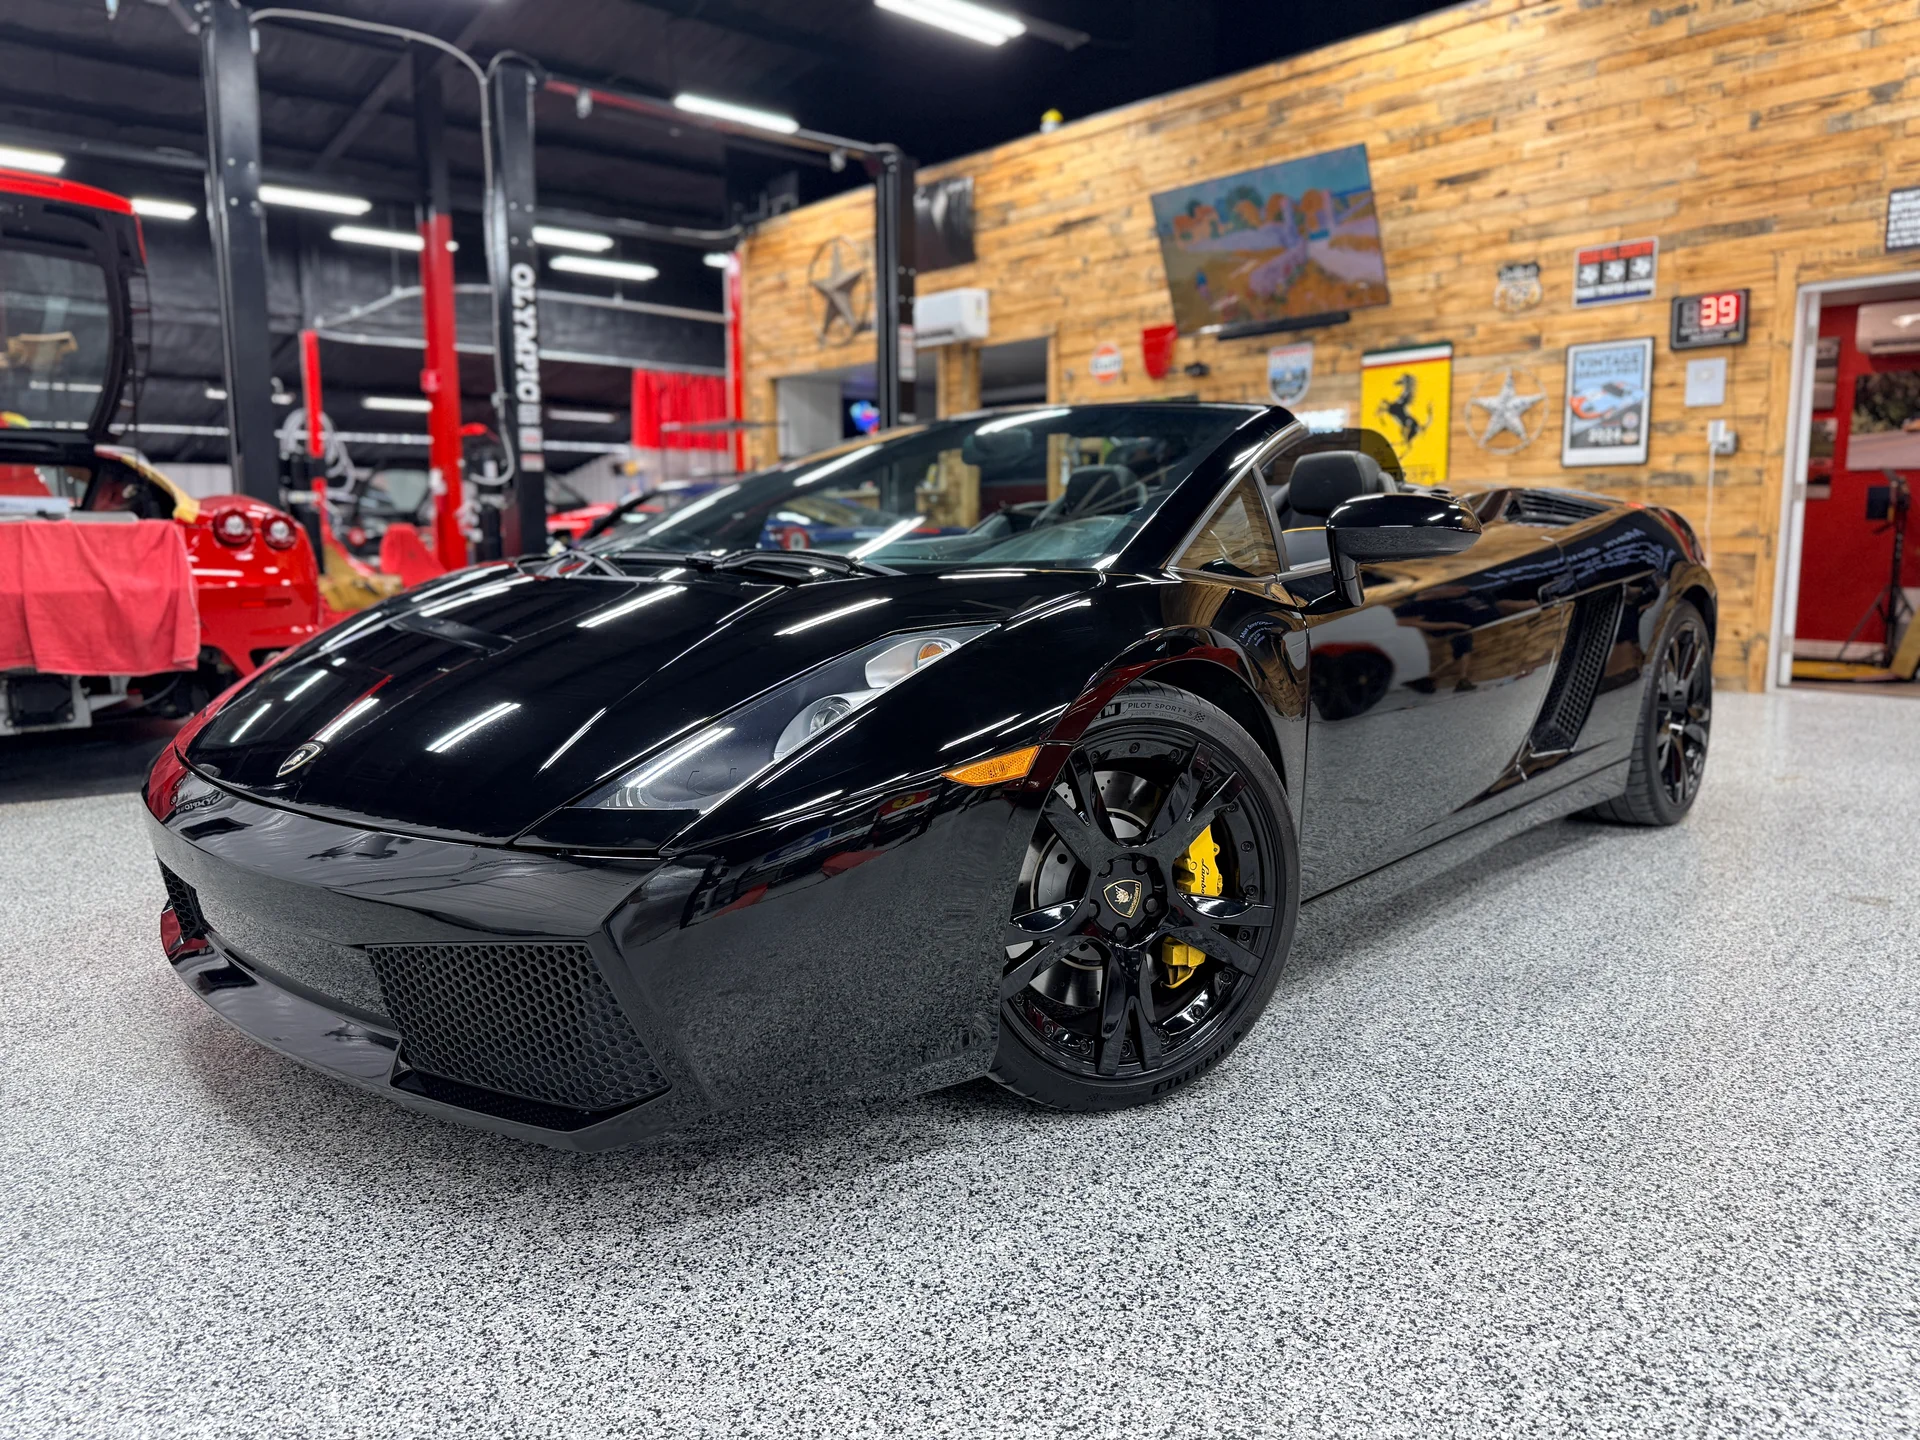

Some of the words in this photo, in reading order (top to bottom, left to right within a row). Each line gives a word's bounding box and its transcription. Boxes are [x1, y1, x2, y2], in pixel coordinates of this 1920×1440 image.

[1700, 294, 1737, 327] 39
[511, 262, 541, 403] OLYMPIC
[1155, 703, 1182, 712] SPORT
